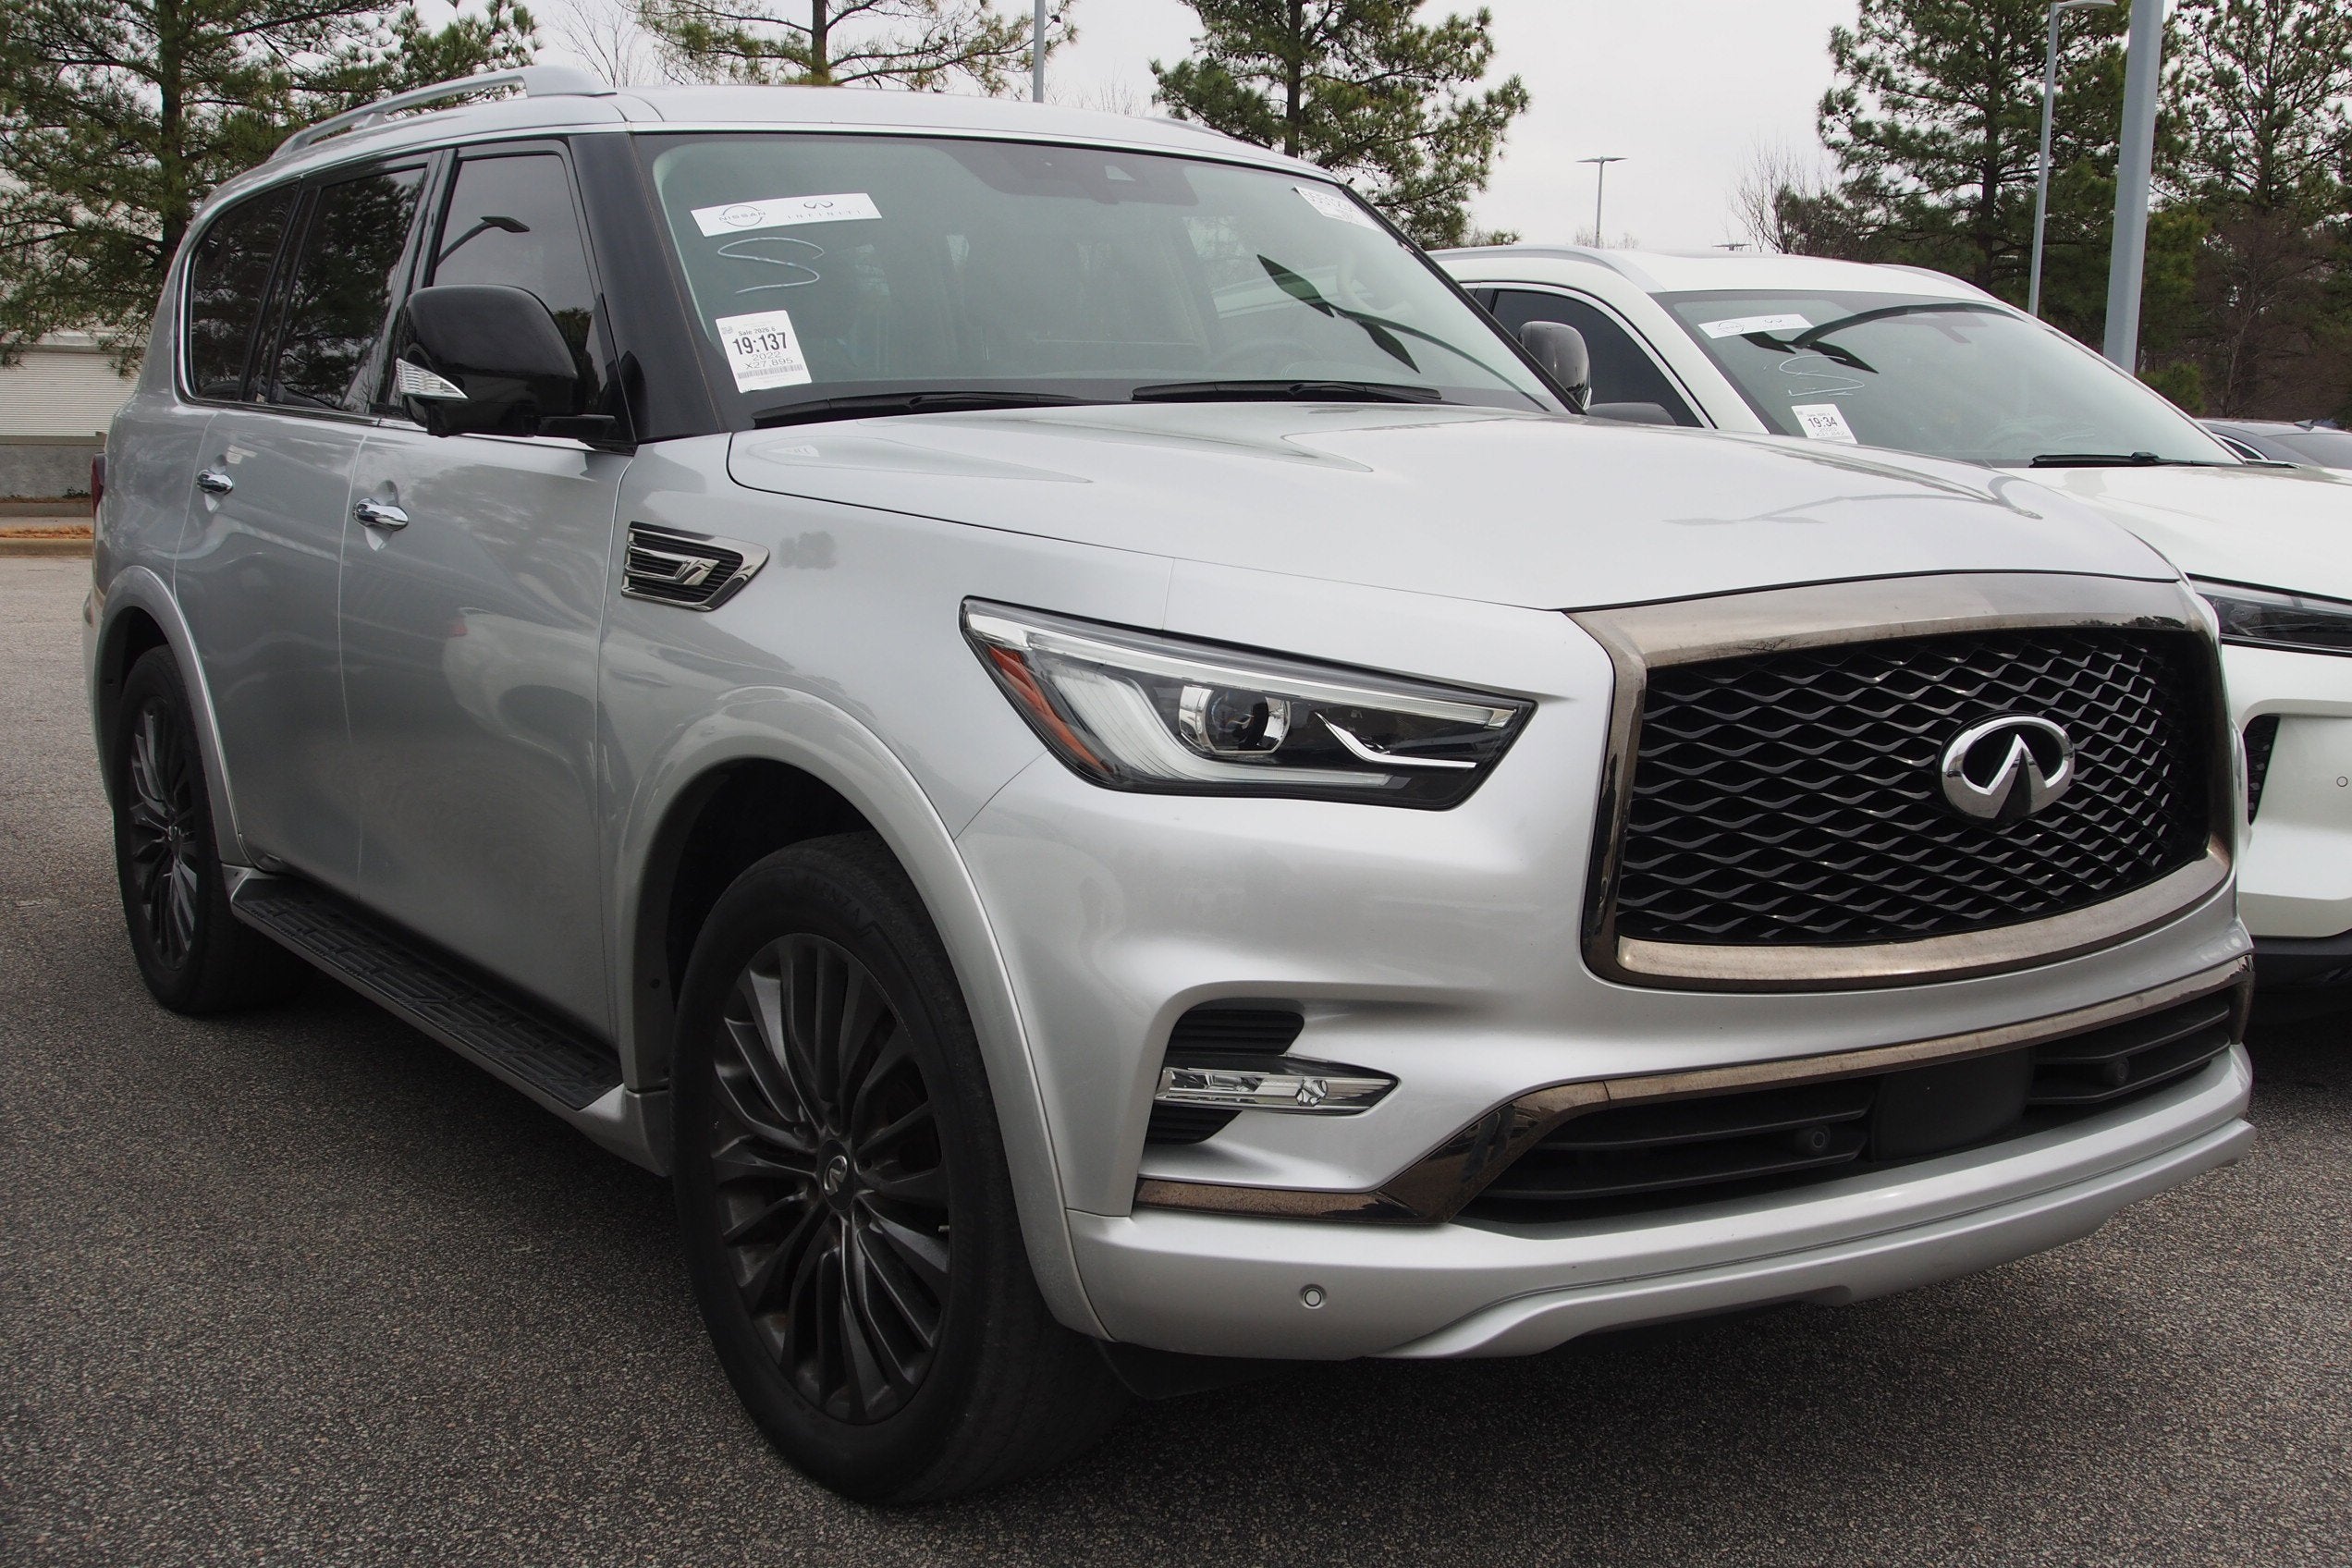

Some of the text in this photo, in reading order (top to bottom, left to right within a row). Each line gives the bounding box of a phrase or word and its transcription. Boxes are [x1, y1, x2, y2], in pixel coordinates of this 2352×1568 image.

[718, 211, 766, 222] NISSAN
[787, 210, 862, 220] INFINITI
[732, 332, 787, 355] 19:137
[752, 351, 781, 361] 2022
[1807, 416, 1838, 428] 19:34
